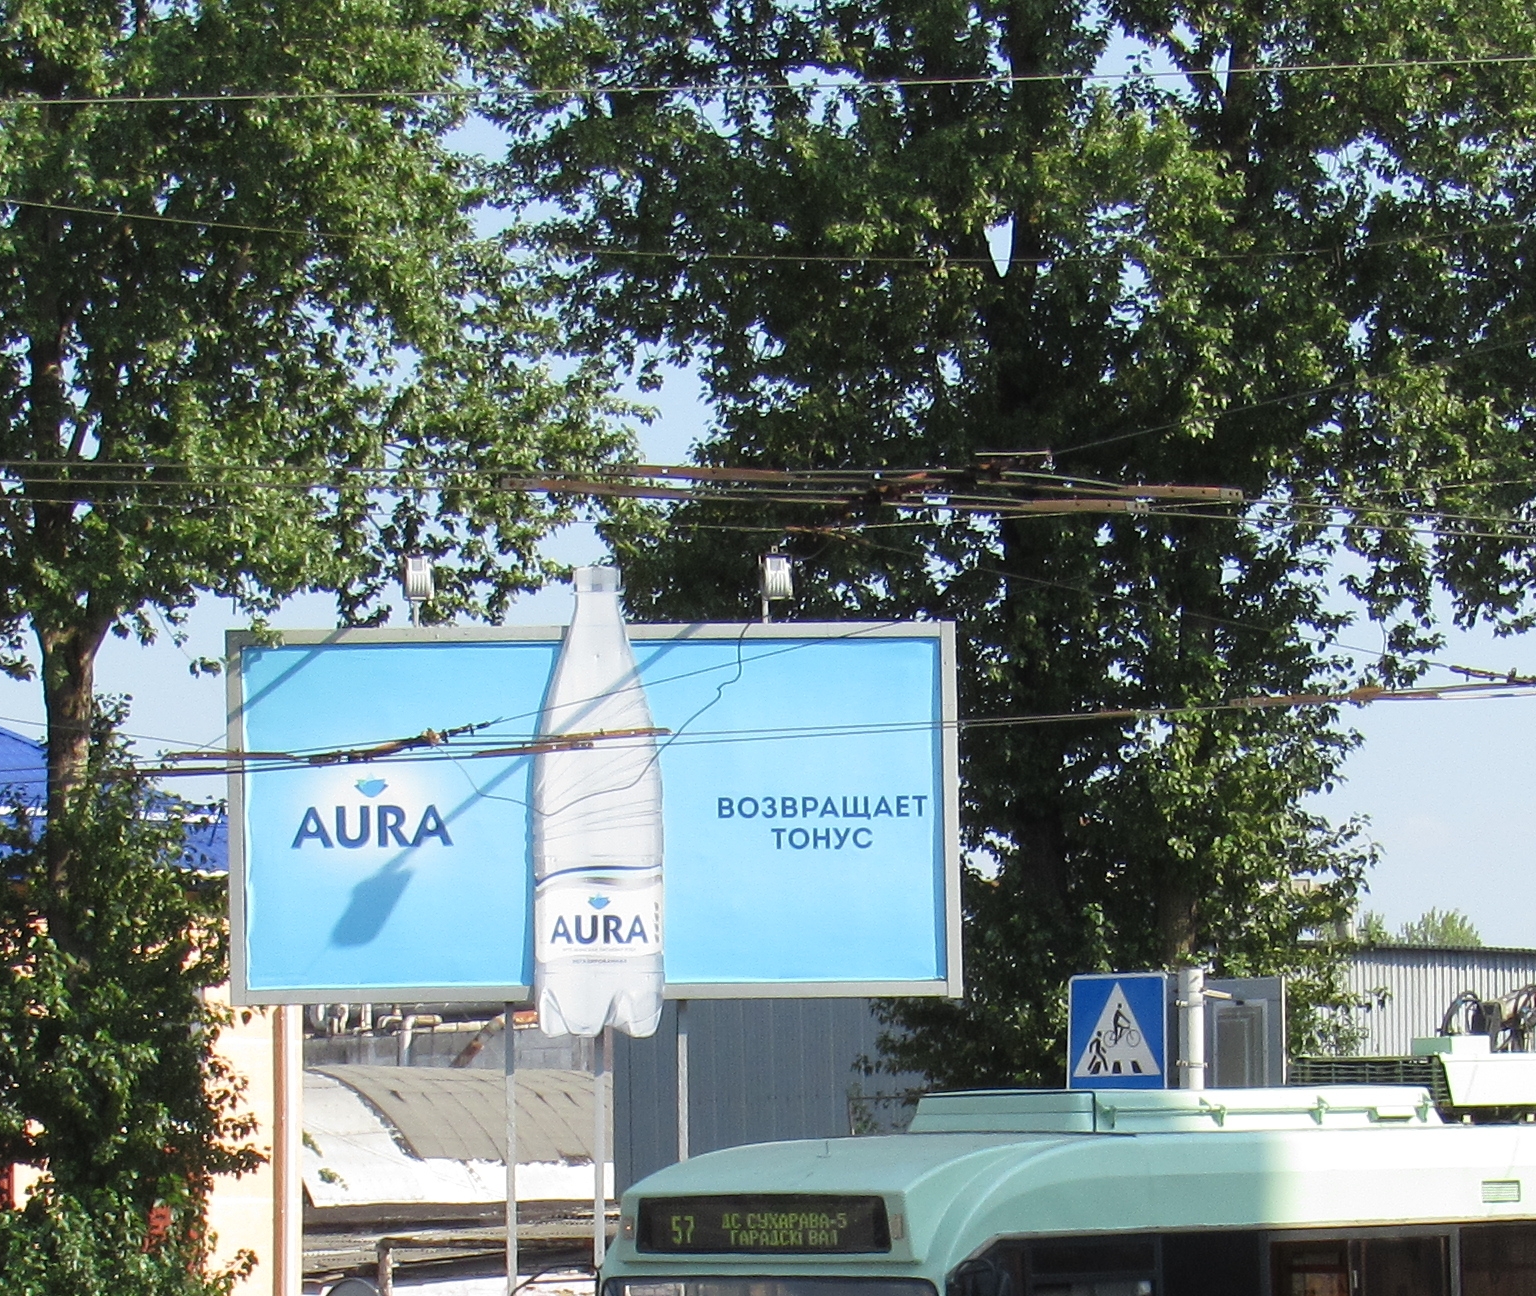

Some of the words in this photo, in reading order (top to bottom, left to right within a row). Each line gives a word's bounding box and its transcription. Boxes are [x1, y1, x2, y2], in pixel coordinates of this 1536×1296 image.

[717, 795, 928, 820] ВОЗВРАЩАЕТ
[291, 804, 454, 849] AURA
[771, 827, 873, 850] ТОНУС
[550, 914, 649, 944] AURA
[671, 1215, 695, 1245] 57
[722, 1213, 741, 1229] ДС
[747, 1212, 848, 1230] СУХАРАВА-5
[730, 1230, 803, 1246] ГАРАДСКІ
[808, 1230, 838, 1246] ВАЛ
